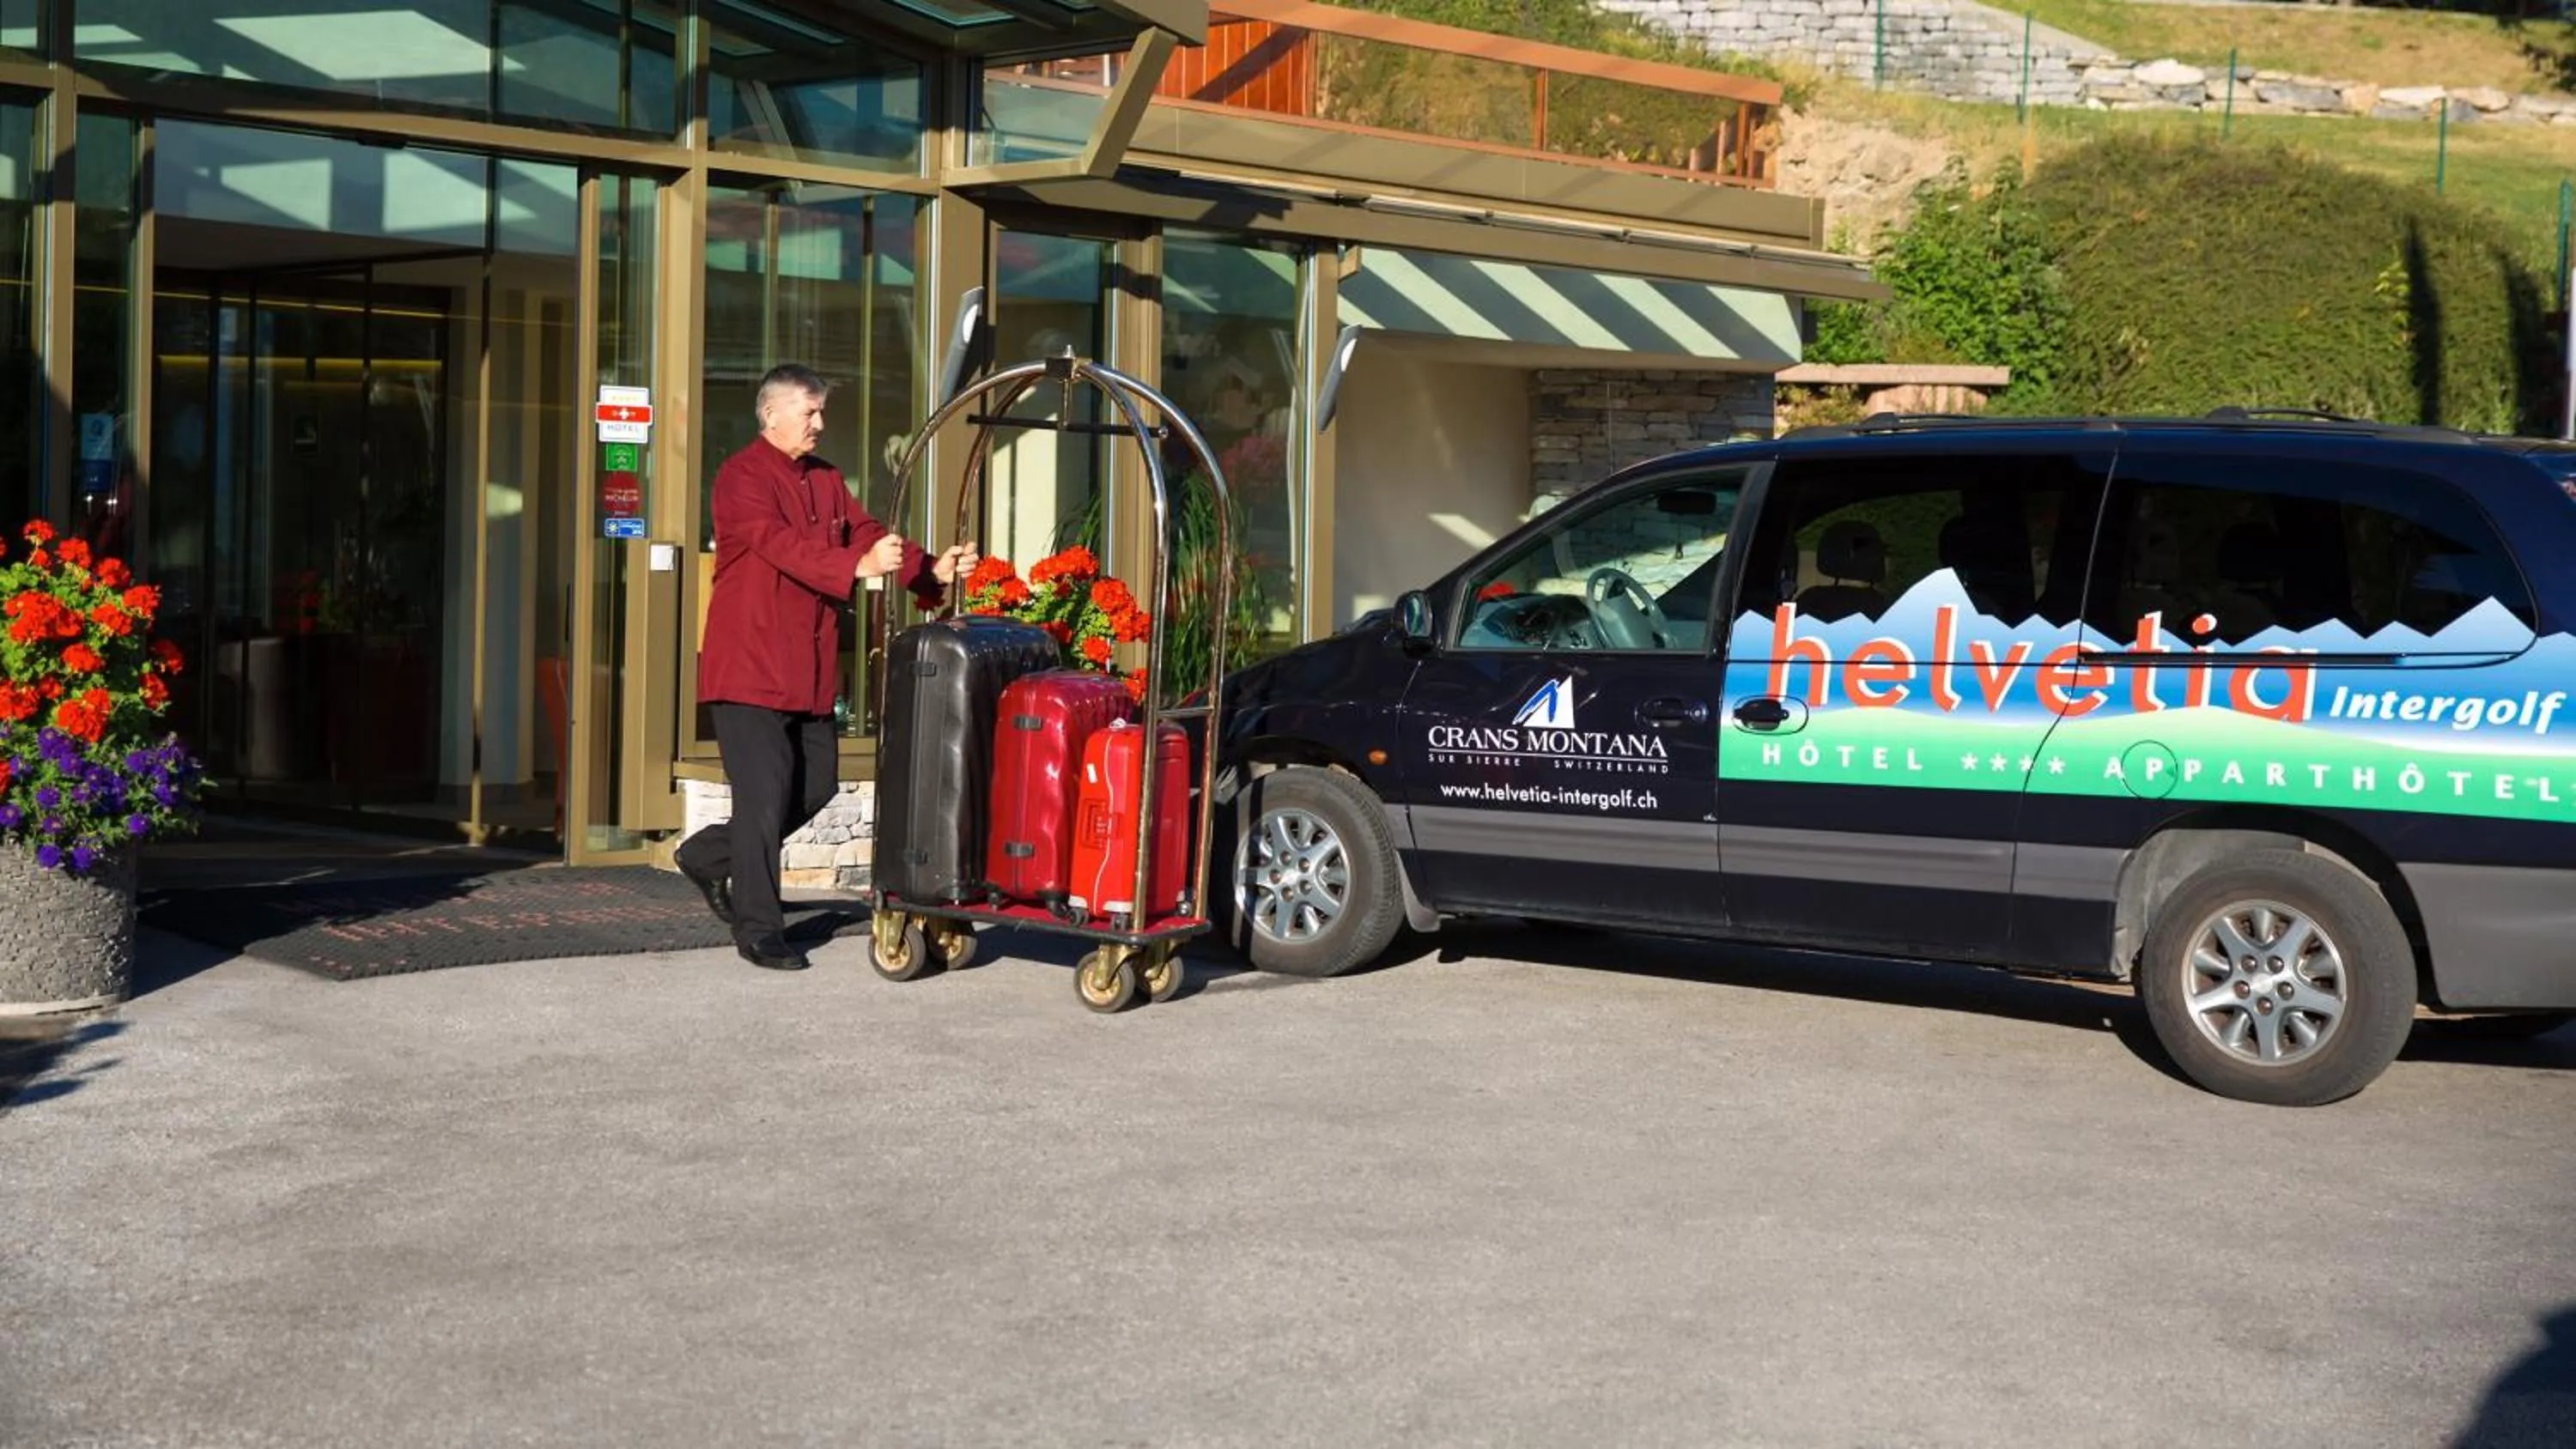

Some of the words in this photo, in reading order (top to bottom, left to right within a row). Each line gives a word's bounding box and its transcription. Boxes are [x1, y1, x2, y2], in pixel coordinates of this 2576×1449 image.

[607, 424, 639, 433] HOTEL
[1765, 602, 2318, 723] helvetia
[2330, 686, 2566, 734] Intergolf
[1428, 725, 1518, 750] CRANS
[1527, 731, 1668, 757] MONTANA
[1762, 740, 1923, 770] HÔTEL
[1428, 754, 1456, 763] SUR
[1467, 755, 1521, 767] SIERRE
[1553, 760, 1668, 773] SWITZERLAND
[1441, 783, 1657, 809] www.helvetia-intergolf.ch
